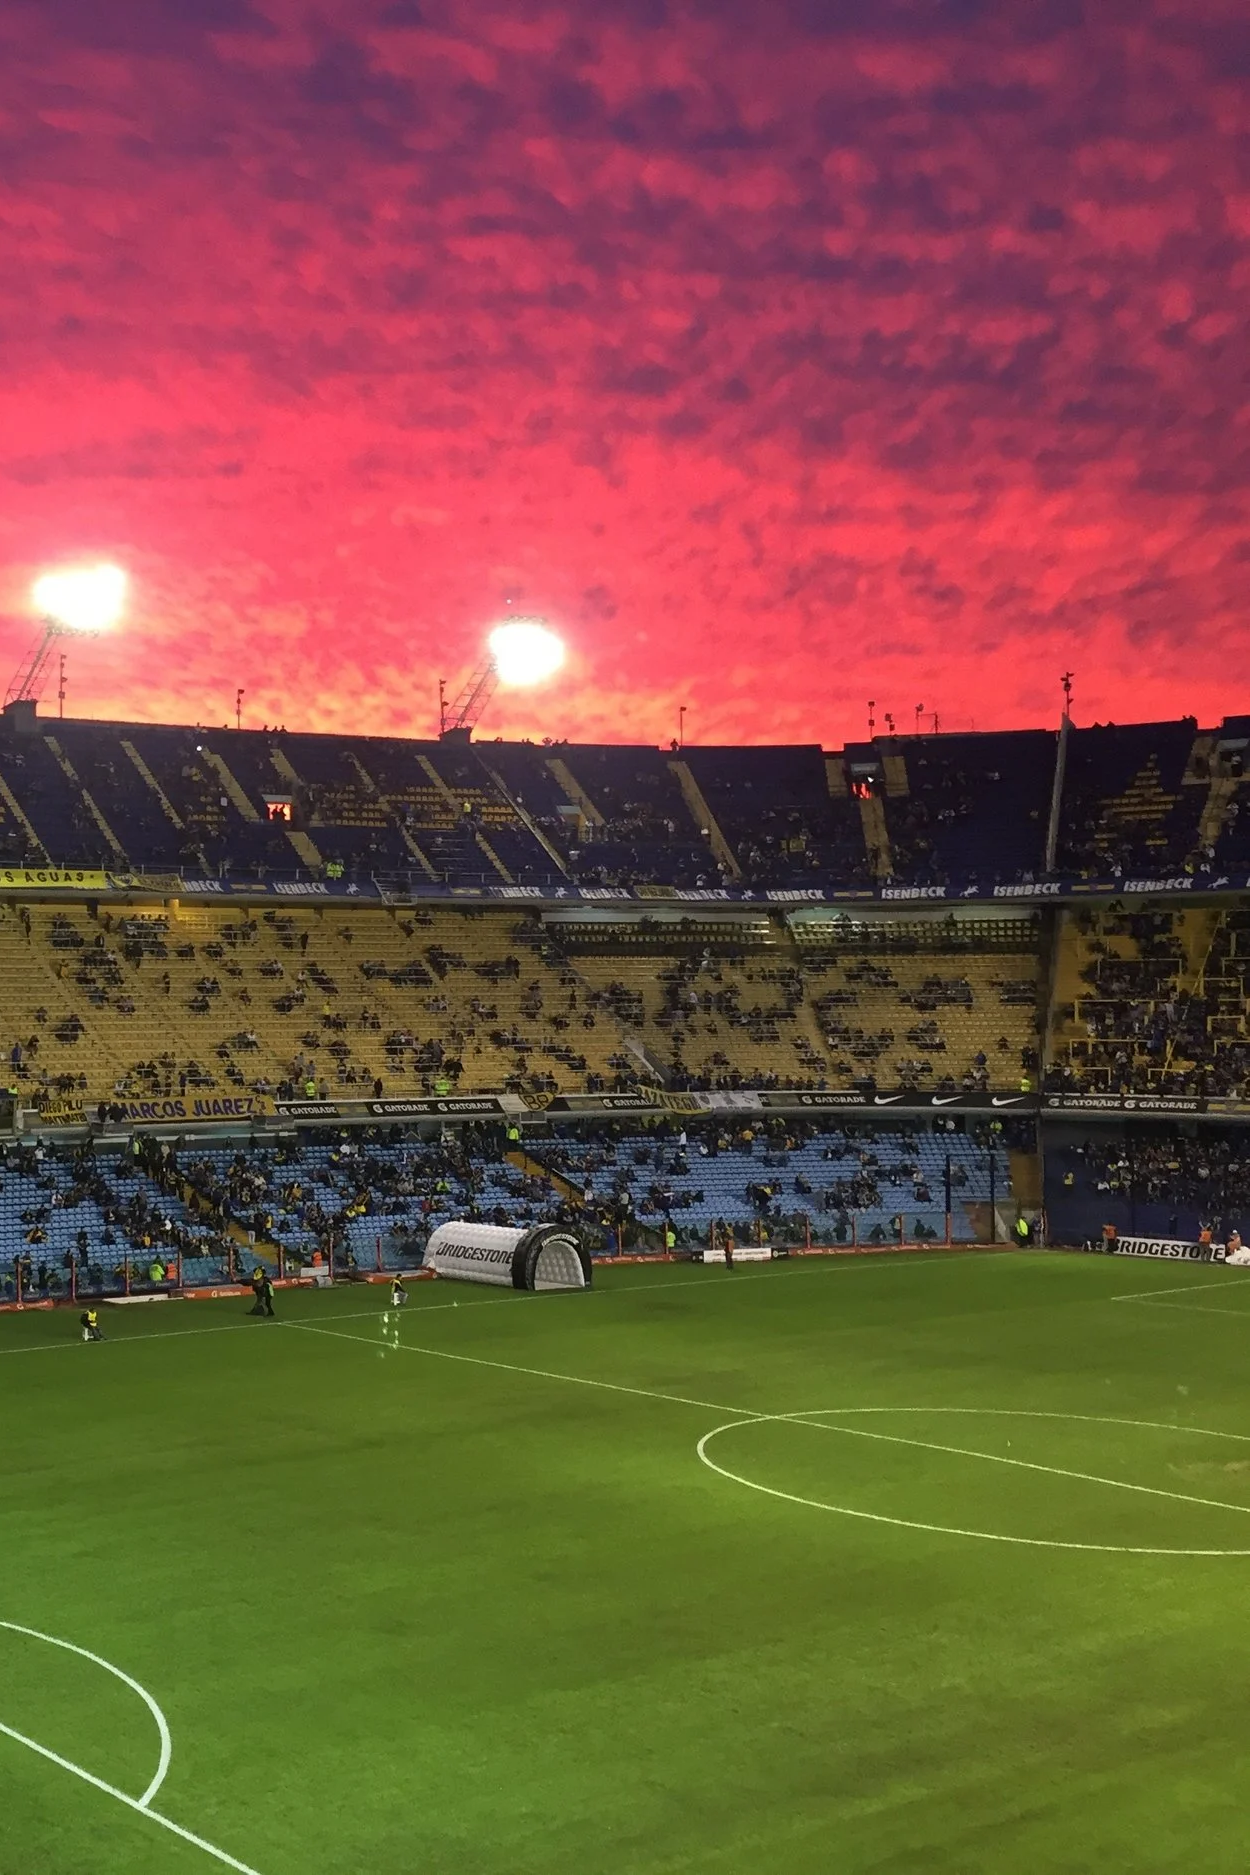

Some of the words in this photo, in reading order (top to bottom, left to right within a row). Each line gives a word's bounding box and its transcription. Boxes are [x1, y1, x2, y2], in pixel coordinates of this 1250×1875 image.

[25, 871, 84, 883] AGUAS
[273, 882, 330, 895] ISENBECK
[993, 883, 1061, 897] ISENBECK
[1124, 878, 1194, 892] ISENBECK
[766, 889, 825, 901] ISENBECK
[881, 886, 946, 899] ISENBECK
[815, 1095, 866, 1104] GATORADE
[1063, 1098, 1121, 1108] GATORADE
[1139, 1100, 1197, 1110] GATORADE
[192, 1097, 257, 1117] JUAREZ
[291, 1106, 338, 1115] GATORADE
[385, 1104, 431, 1112] GATORADE
[449, 1102, 494, 1111] GATORADE
[436, 1241, 514, 1264] BRIDGESTONE
[1112, 1238, 1225, 1261] RIDGESTOE
